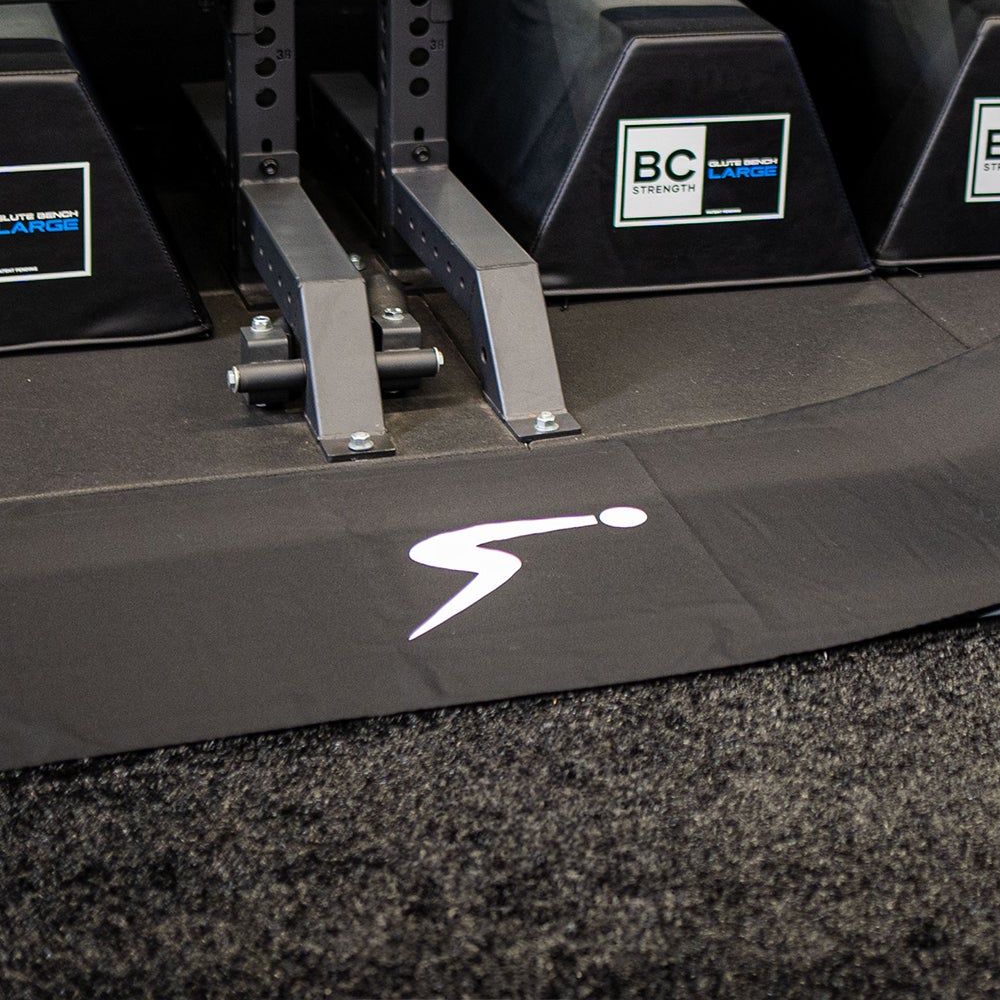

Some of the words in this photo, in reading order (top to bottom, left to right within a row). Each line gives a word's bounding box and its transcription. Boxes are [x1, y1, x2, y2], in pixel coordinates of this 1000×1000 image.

[633, 149, 697, 183] BC
[708, 159, 742, 168] GLUTE
[743, 157, 778, 166] BENCH
[708, 165, 778, 179] LARGE
[632, 184, 696, 195] STRENGTH
[0, 213, 35, 222] LUTE
[36, 210, 79, 220] BENCH
